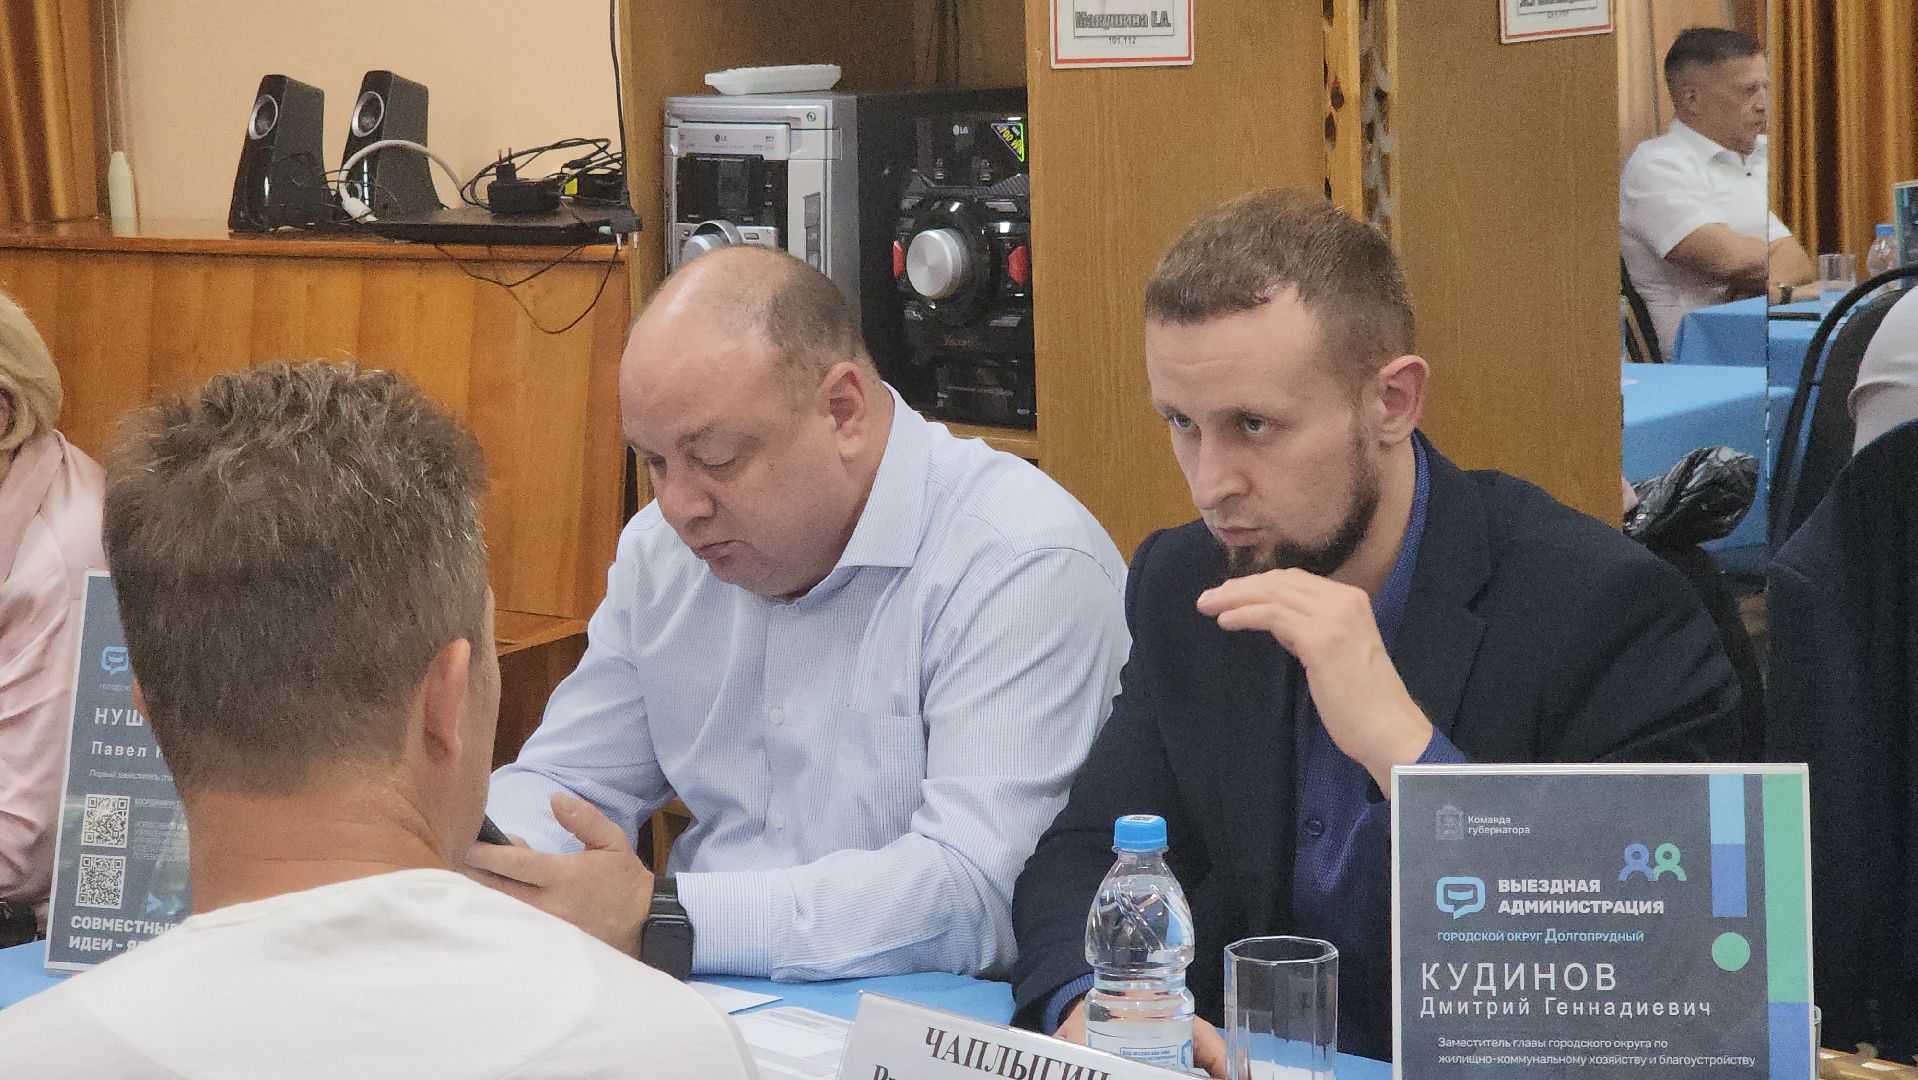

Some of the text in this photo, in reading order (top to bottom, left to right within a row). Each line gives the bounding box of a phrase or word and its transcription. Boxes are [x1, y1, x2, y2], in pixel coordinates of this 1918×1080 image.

[91, 741, 147, 757] Павел
[1468, 815, 1511, 824] Команда
[1468, 825, 1530, 835] губернатора
[1498, 879, 1601, 894] ВЫЕЗДНАЯ
[1498, 900, 1664, 915] АДМИНИСТРАЦИЯ
[70, 915, 179, 936] СОВМЕСТНЫ
[68, 935, 113, 952] ИДЕИ
[1421, 962, 1617, 996] КУДИНОВ
[1420, 997, 1711, 1019] Дмитрий Геннадиевич
[1438, 1037, 1669, 1051] Заместитель главы городского округа по
[1438, 1053, 1756, 1067] жилищно-коммунальному хозяйству и благоустройству
